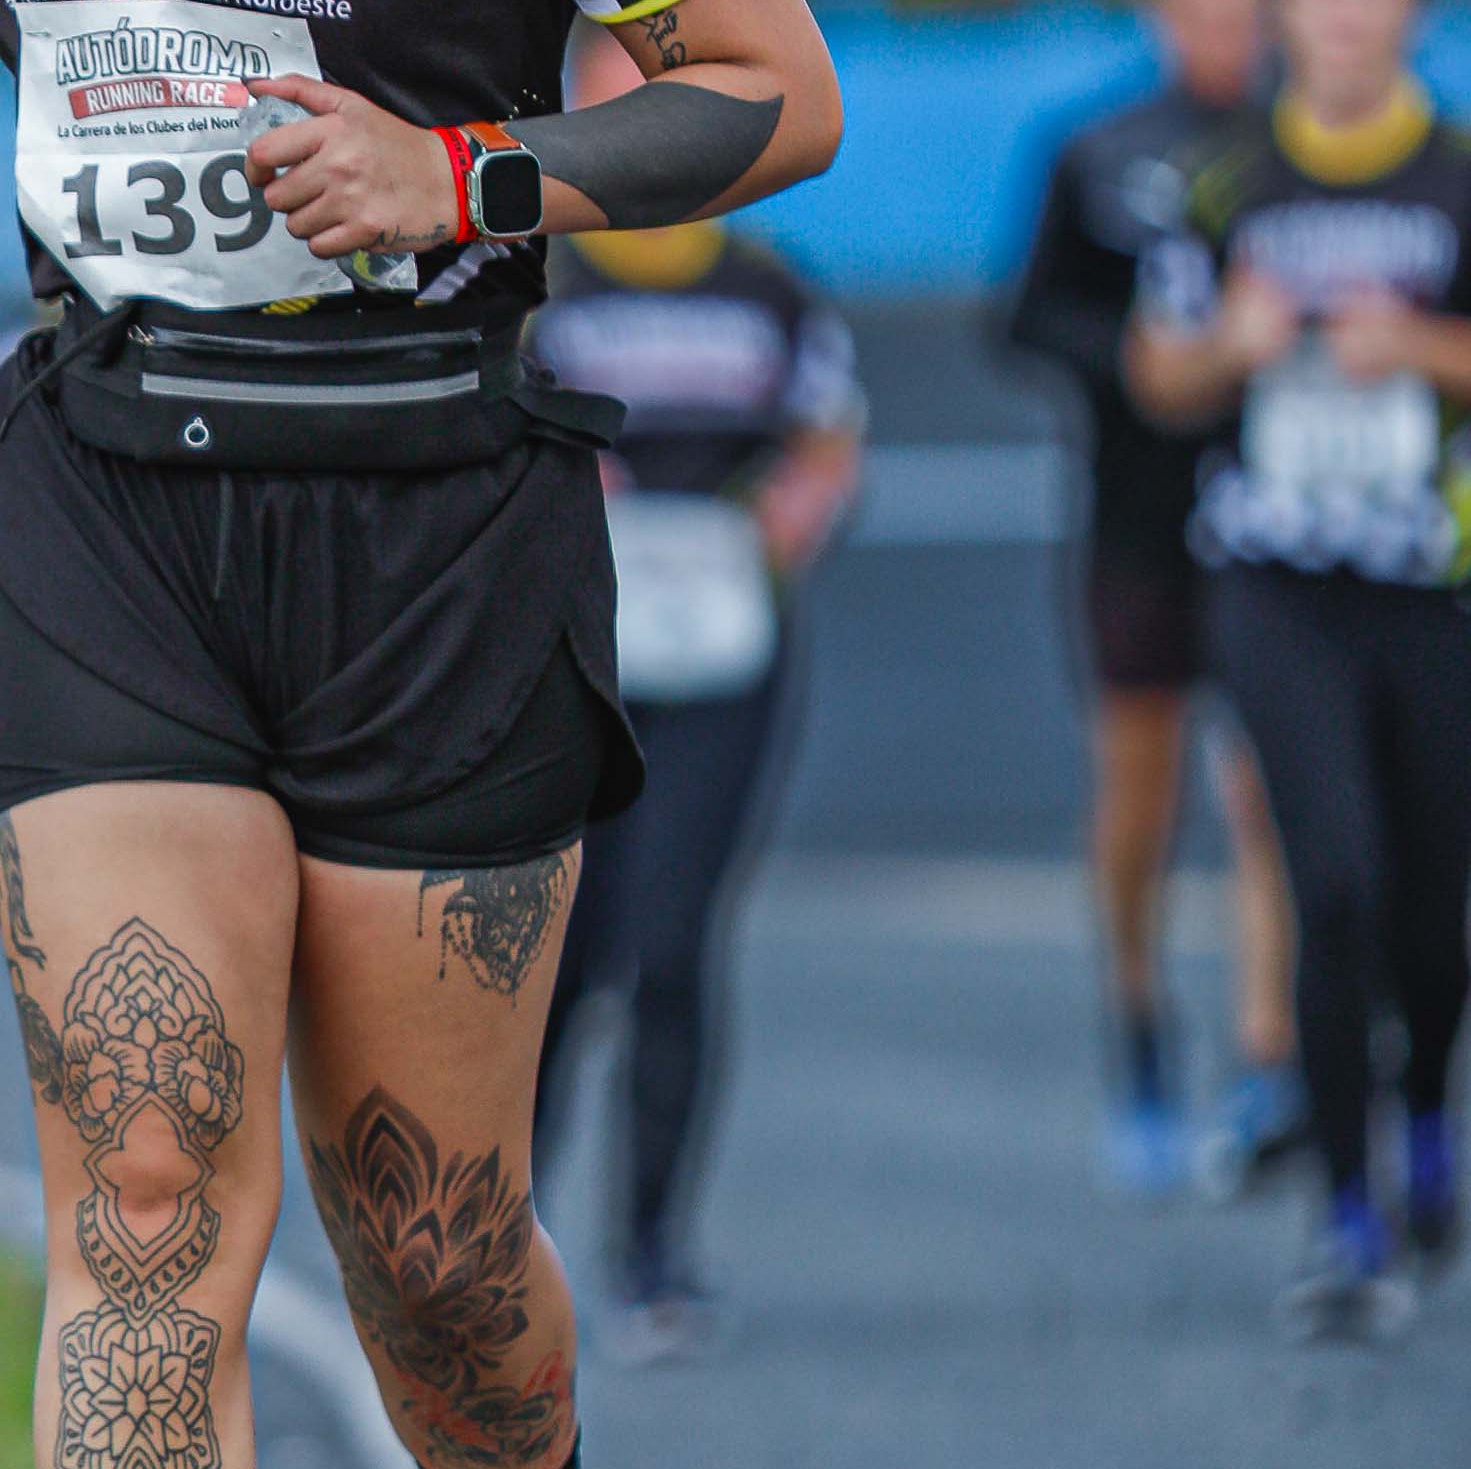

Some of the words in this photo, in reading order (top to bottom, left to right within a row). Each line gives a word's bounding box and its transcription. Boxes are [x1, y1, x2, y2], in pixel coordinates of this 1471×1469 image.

[55, 16, 271, 86] AUTÓDROMO
[85, 81, 165, 115] RUNNING
[169, 81, 227, 107] RACE
[57, 125, 70, 139] La
[71, 122, 111, 138] Carrera
[113, 120, 128, 135] de
[129, 119, 146, 135] los
[146, 118, 185, 134] Clubes
[187, 116, 208, 132] del
[61, 151, 275, 260] 139
